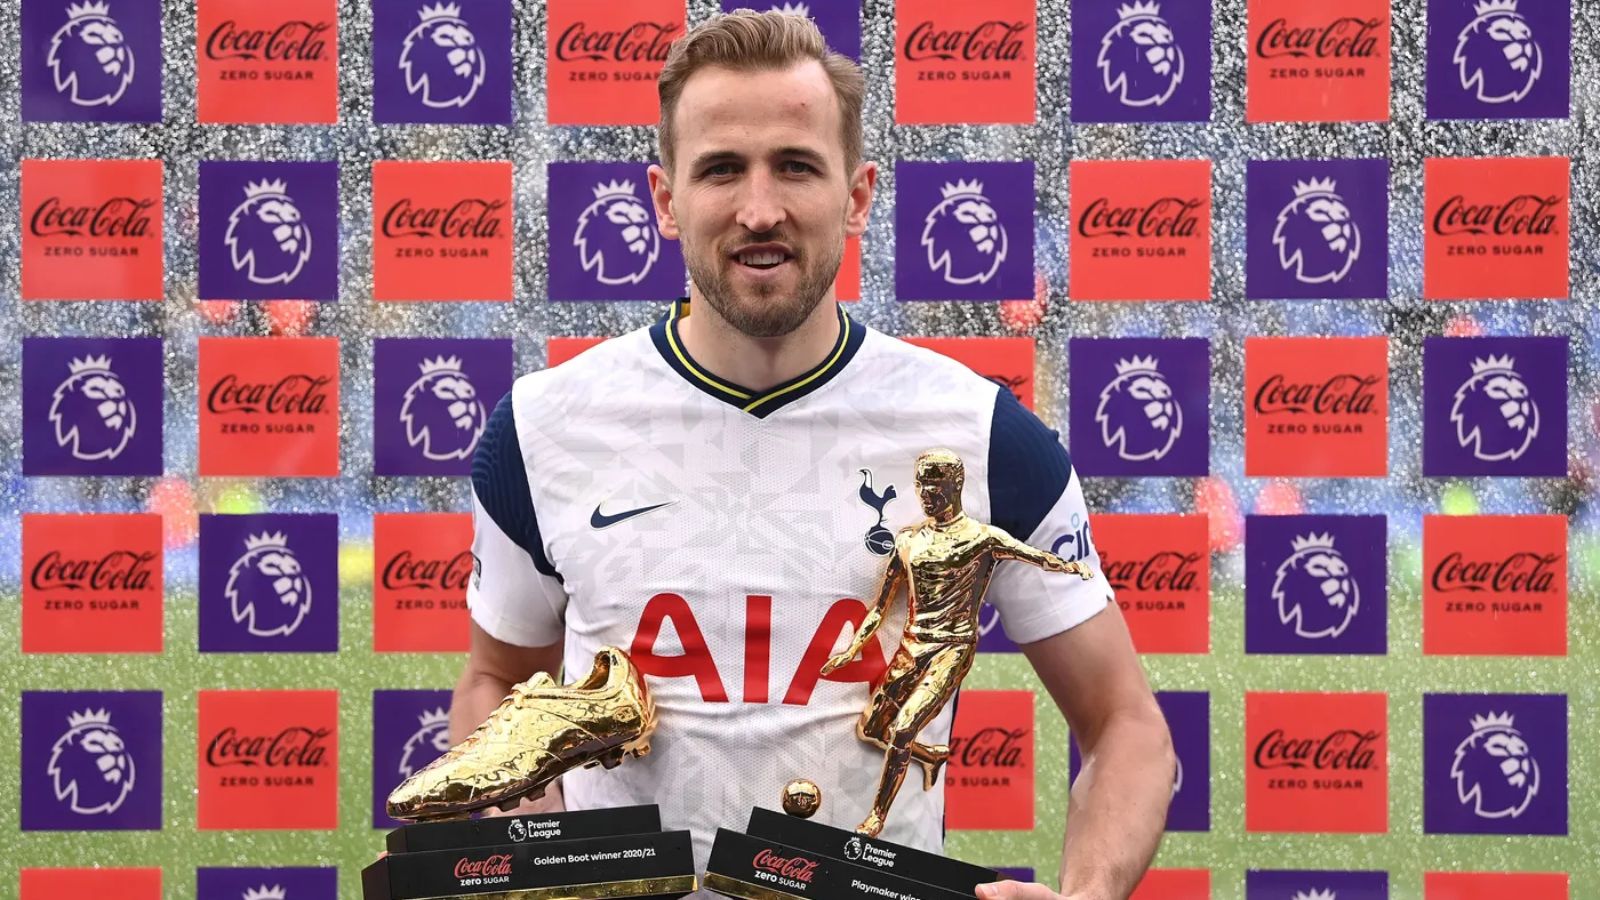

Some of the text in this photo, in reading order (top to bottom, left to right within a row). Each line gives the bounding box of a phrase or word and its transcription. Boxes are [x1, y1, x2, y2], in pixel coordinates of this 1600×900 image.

[205, 21, 331, 61] Coca-Cola
[904, 21, 1027, 61] Coca-Cola
[1256, 18, 1382, 59] Coca-Cola
[219, 70, 314, 81] ZERO SUGAR
[569, 71, 608, 81] ZERO
[918, 70, 1011, 81] ZERO SUGAR
[1270, 67, 1365, 78] ZERO SUGAR
[30, 198, 154, 238] Coca-Cola
[382, 199, 504, 239] Coca-Cola
[1078, 198, 1202, 238] Coca-Cola
[1433, 195, 1561, 236] Coca-Cola
[44, 246, 139, 257] ZERO SUGAR
[395, 248, 489, 257] ZERO SUGAR
[1092, 247, 1186, 257] ZERO SUGAR
[1447, 245, 1544, 256] ZERO SUGAR
[207, 375, 330, 414] Coca-Cola
[1253, 375, 1379, 415] Coca-Cola
[221, 423, 315, 433] ZERO SUGAR
[1267, 424, 1363, 434] ZERO SUGAR
[30, 551, 156, 591] Coca-Cola
[1431, 552, 1560, 593] Coca-Cola
[44, 600, 140, 611] ZERO SUGAR
[396, 600, 468, 610] ZERO SUG
[1136, 601, 1185, 611] SUGAR
[1445, 602, 1543, 613] ZERO SUGAR
[629, 592, 888, 706] AIA
[206, 727, 332, 767] Coca-Cola
[1253, 729, 1380, 770] Coca-Cola
[219, 776, 315, 787] ZERO SUGAR
[961, 777, 1010, 787] SUGAR
[1268, 778, 1363, 789] ZERO SUGAR
[527, 820, 561, 830] Premier
[528, 828, 561, 839] League
[534, 847, 656, 866] Golden Boot winner 2020/21
[862, 849, 895, 868] League
[865, 843, 897, 859] Premier
[454, 853, 513, 879] Coca-Cola
[752, 848, 820, 882] Coca-Cola
[460, 876, 510, 887] zero SUGAR
[754, 870, 807, 891] zero SUGAR
[851, 879, 899, 899] Playmaker
